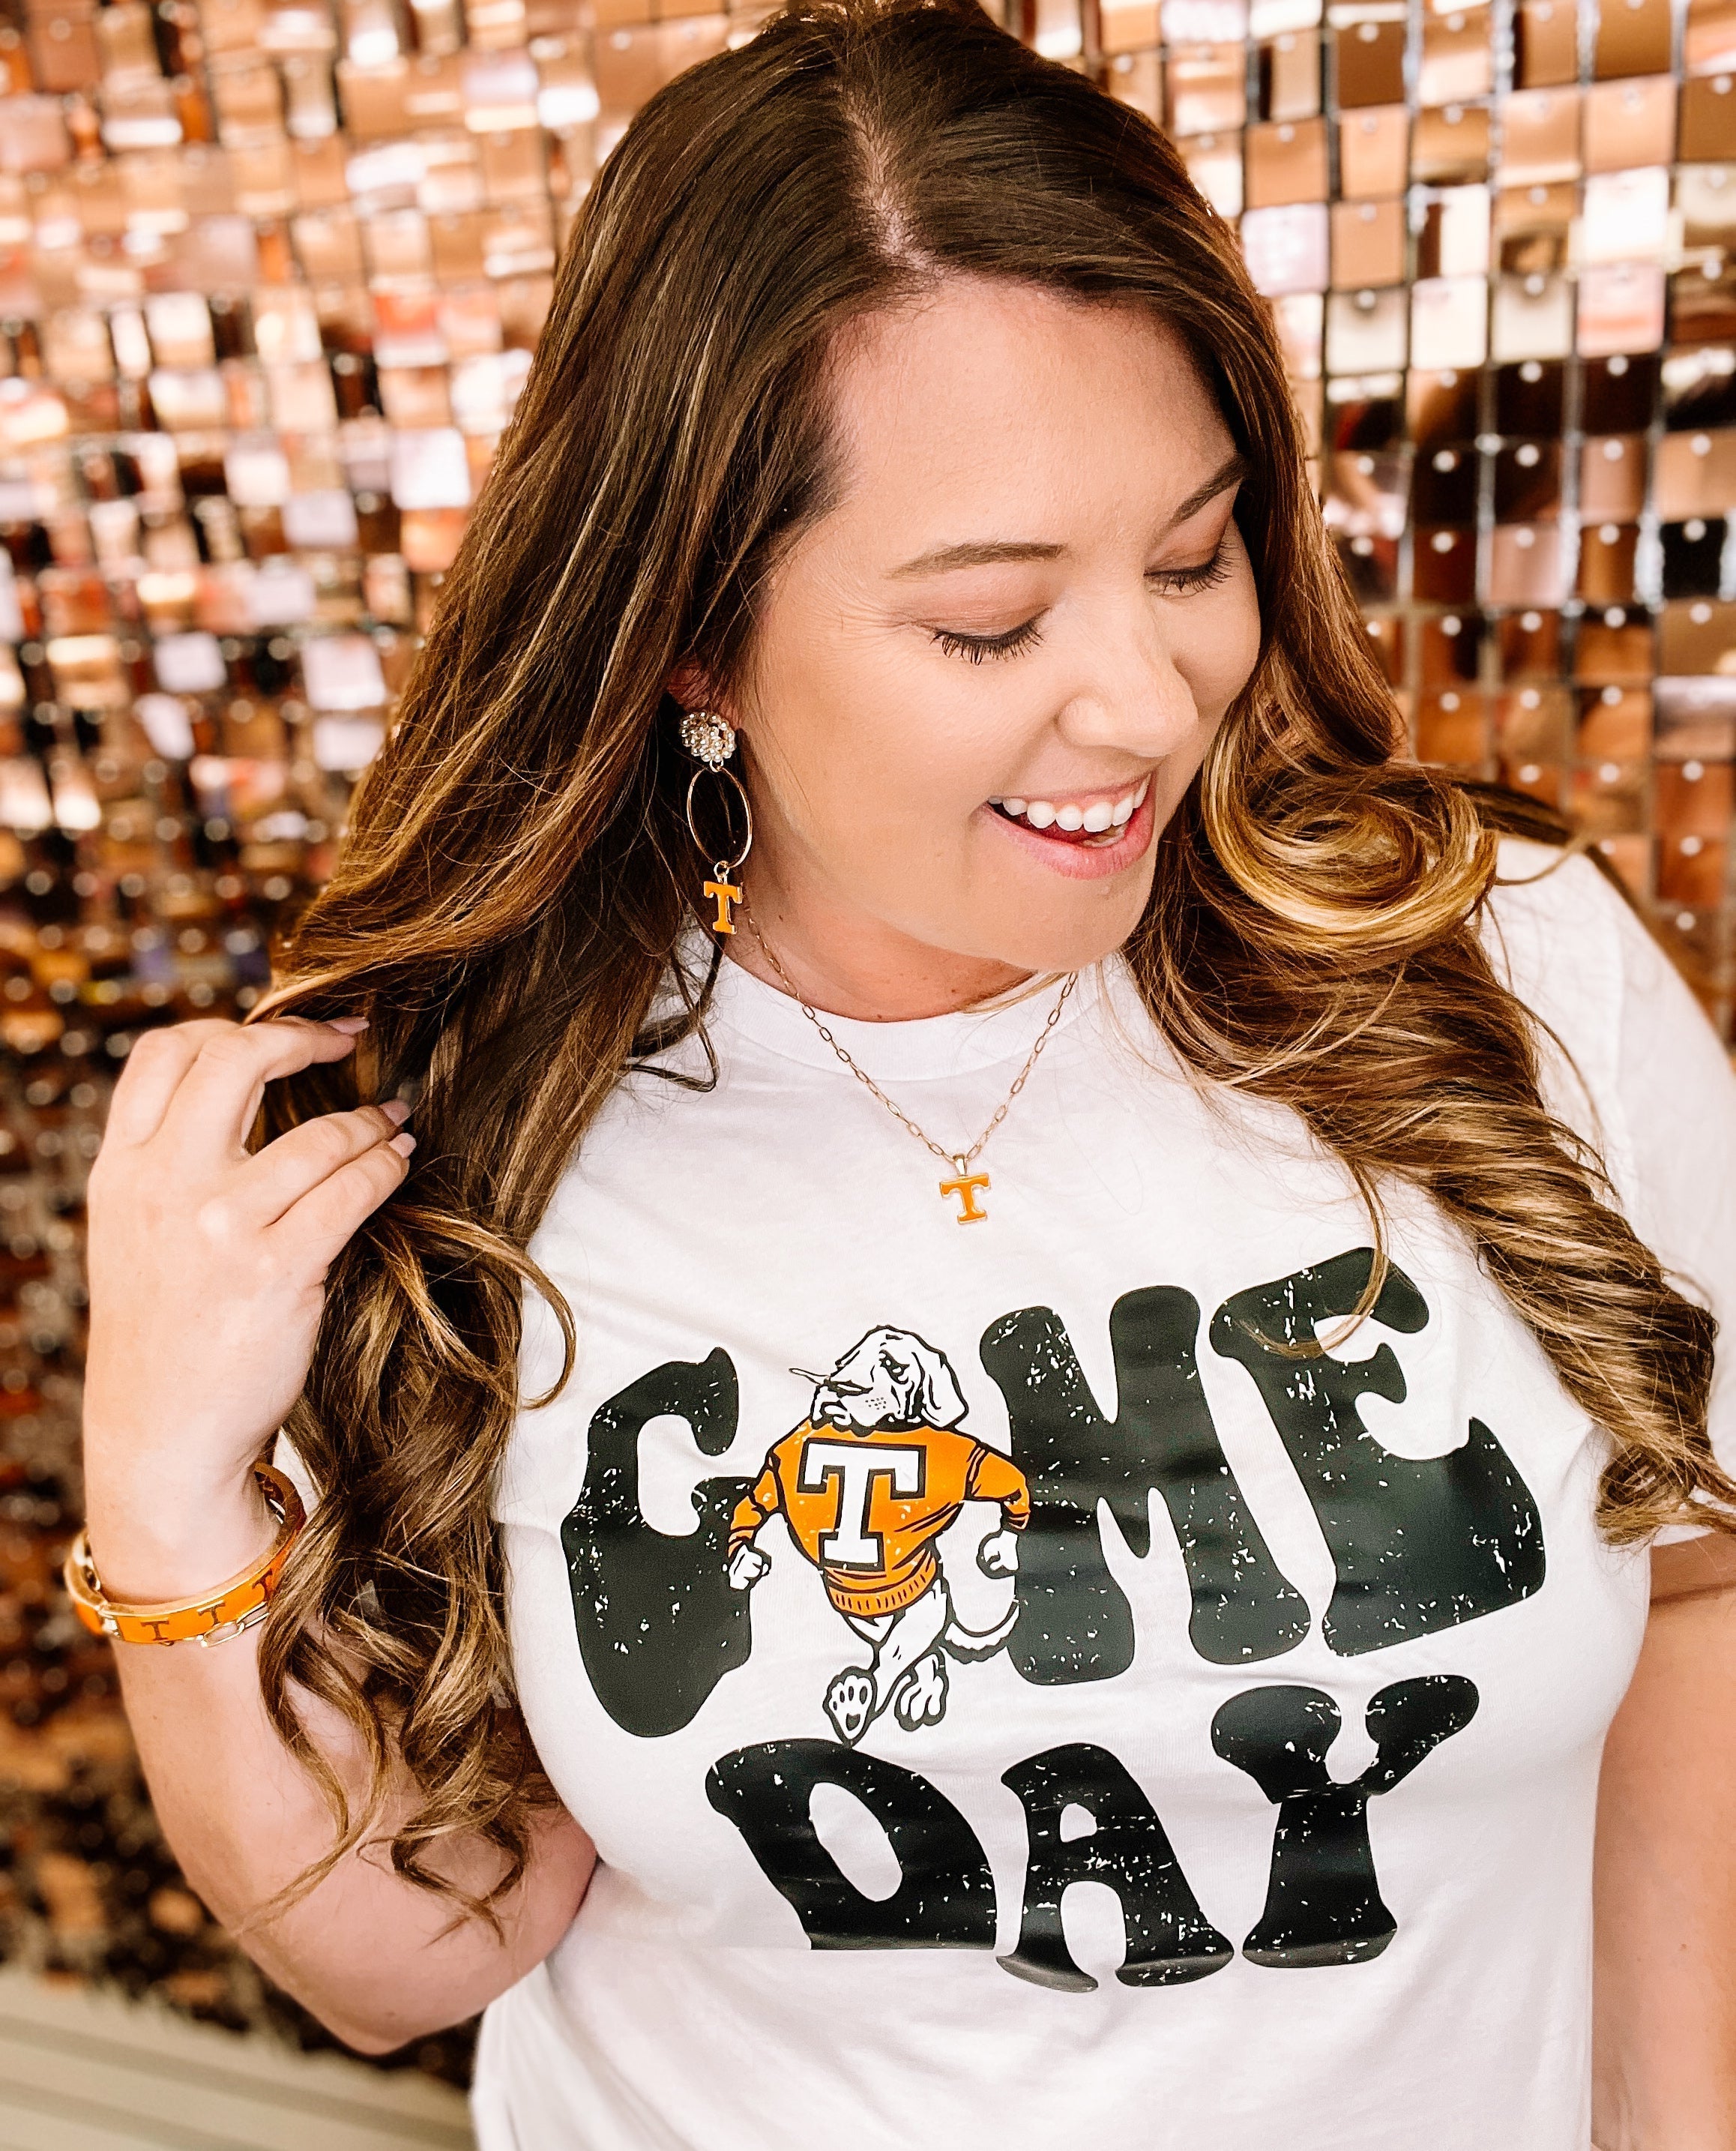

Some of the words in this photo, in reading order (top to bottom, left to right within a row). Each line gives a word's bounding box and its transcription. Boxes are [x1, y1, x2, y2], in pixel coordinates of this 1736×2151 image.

[703, 880, 743, 934] T
[939, 1173, 991, 1224] T
[561, 1246, 1546, 1738] GME
[798, 1437, 927, 1571] T
[705, 1674, 1480, 1994] DAY
